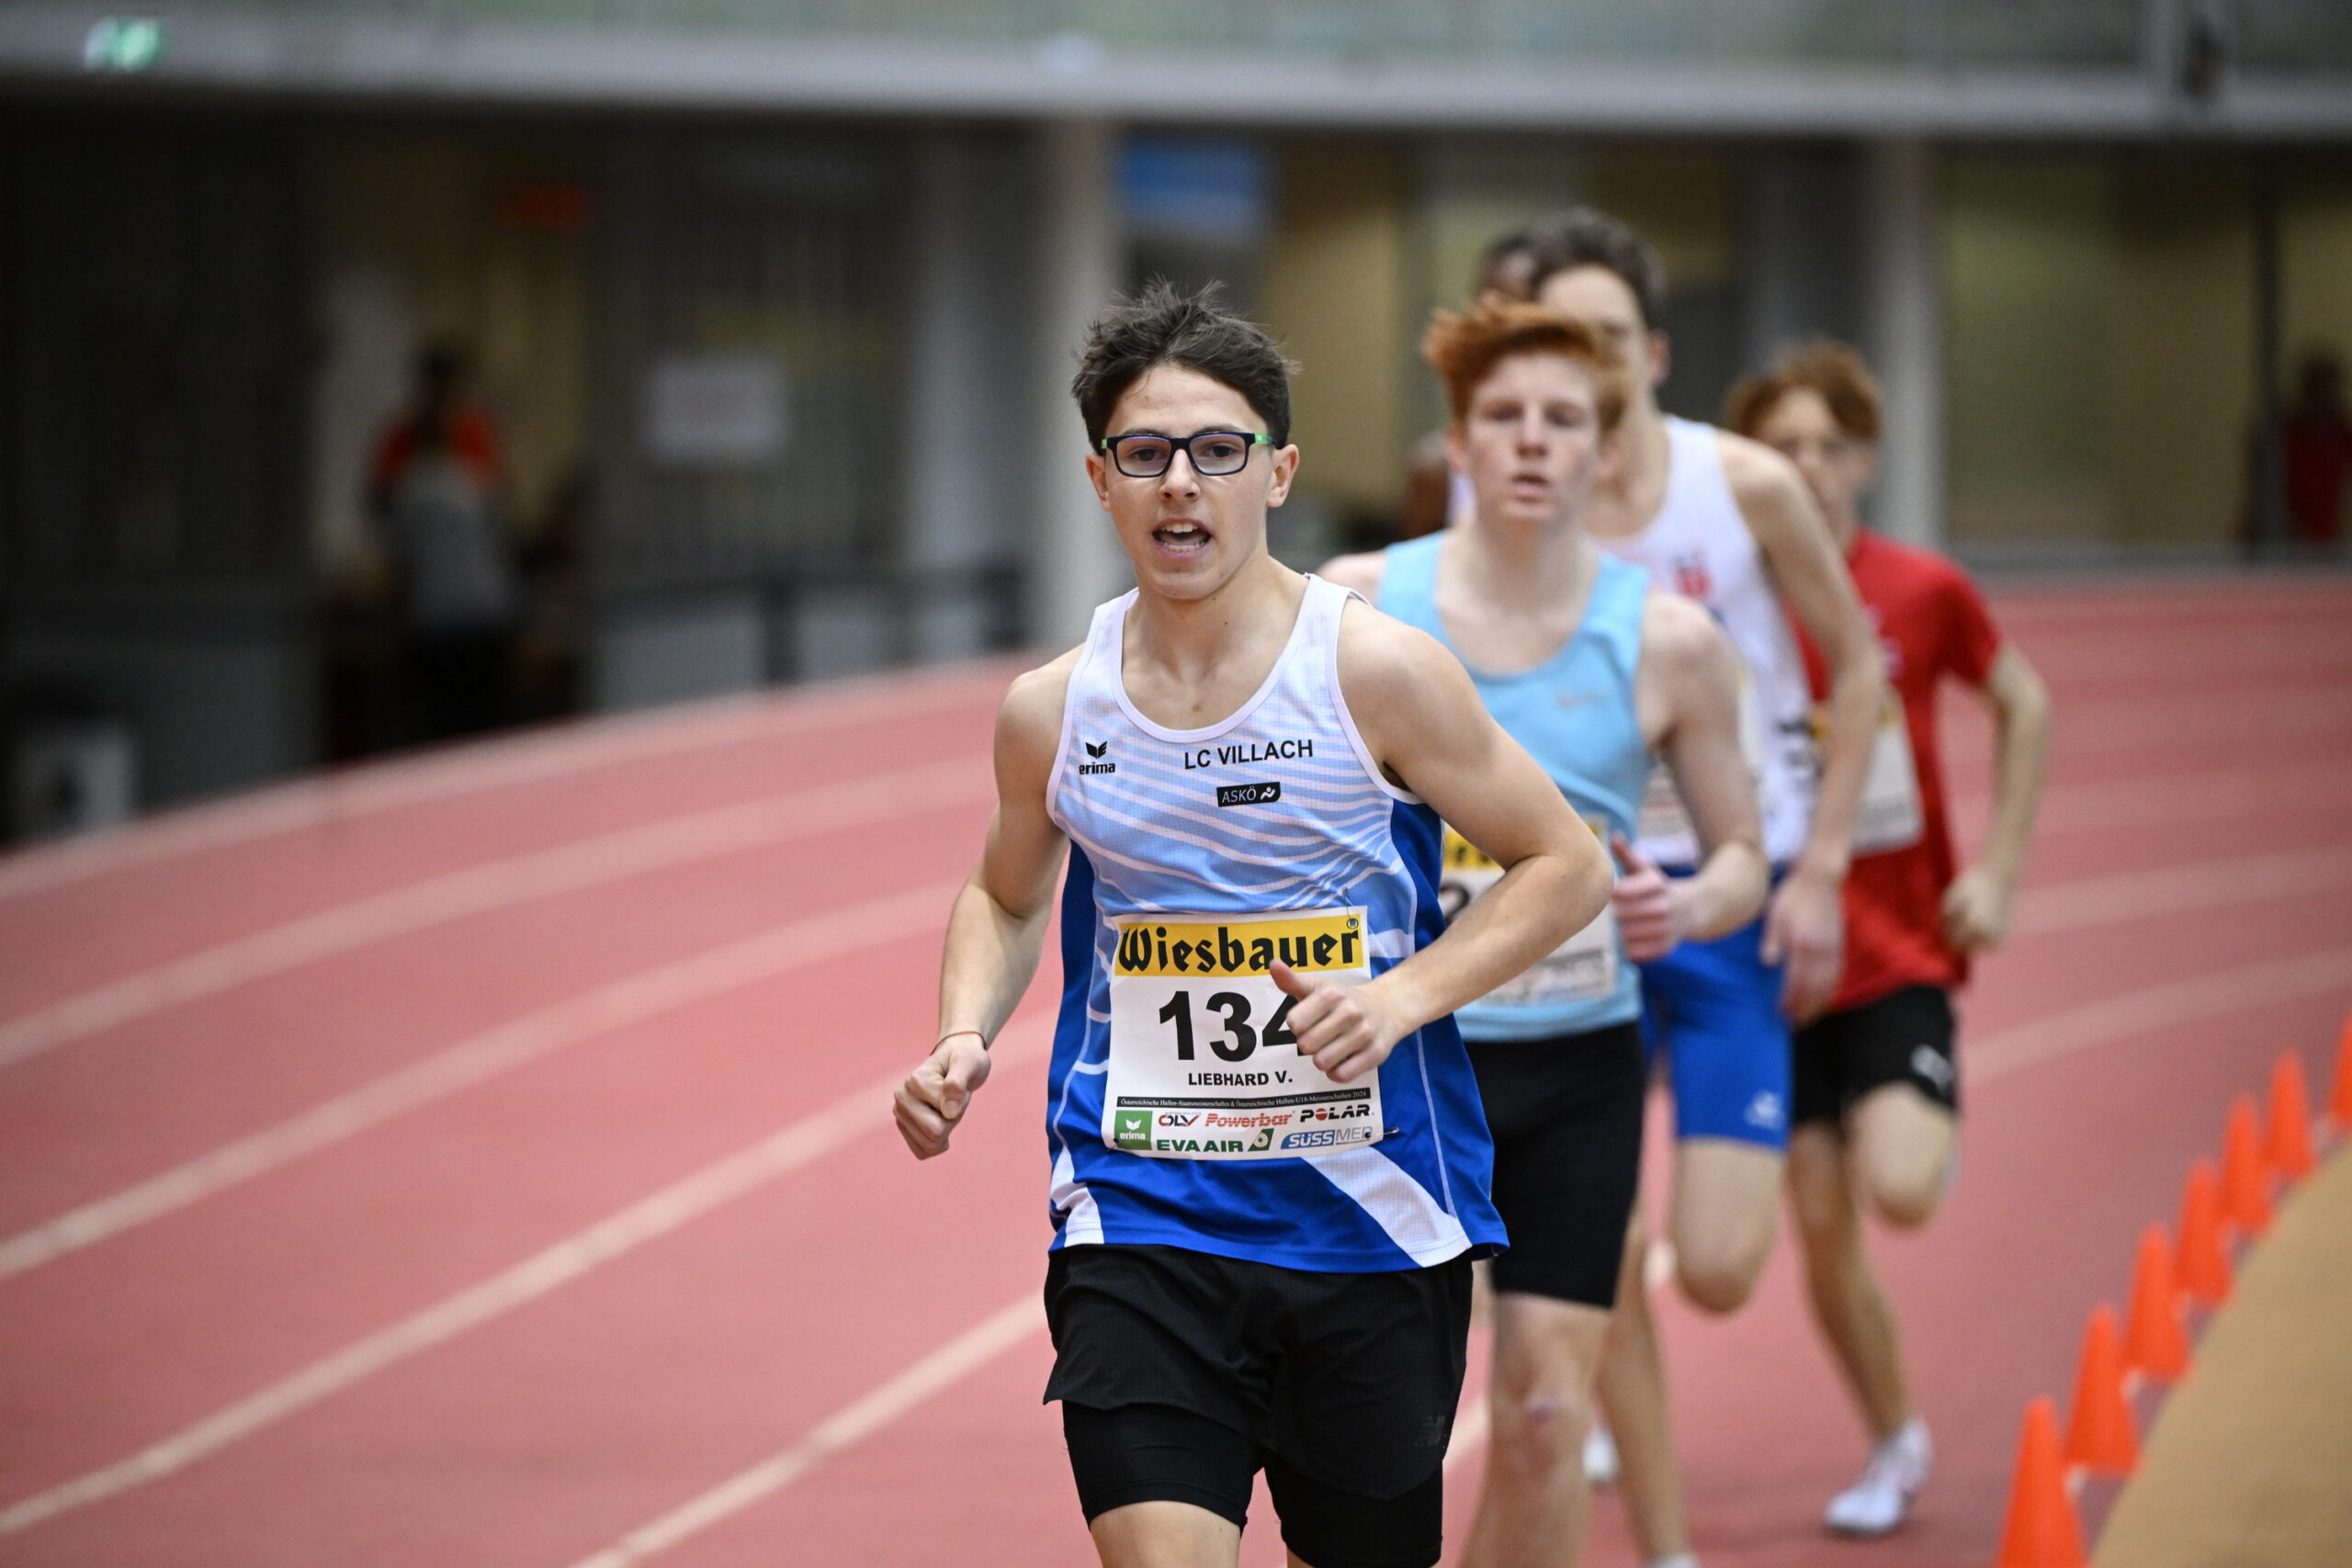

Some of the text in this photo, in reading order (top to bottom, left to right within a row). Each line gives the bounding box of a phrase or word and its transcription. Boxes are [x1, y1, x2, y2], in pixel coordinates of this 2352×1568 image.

[1184, 739, 1314, 770] LC VILLACH
[1079, 761, 1116, 775] erima
[1221, 786, 1257, 804] ASKÖ
[1118, 926, 1359, 974] Wiesbauer
[1188, 1070, 1293, 1087] LIEBHARD V.
[1204, 1112, 1293, 1127] Powerbar
[1300, 1104, 1371, 1122] POLAR
[1119, 1131, 1147, 1140] erima
